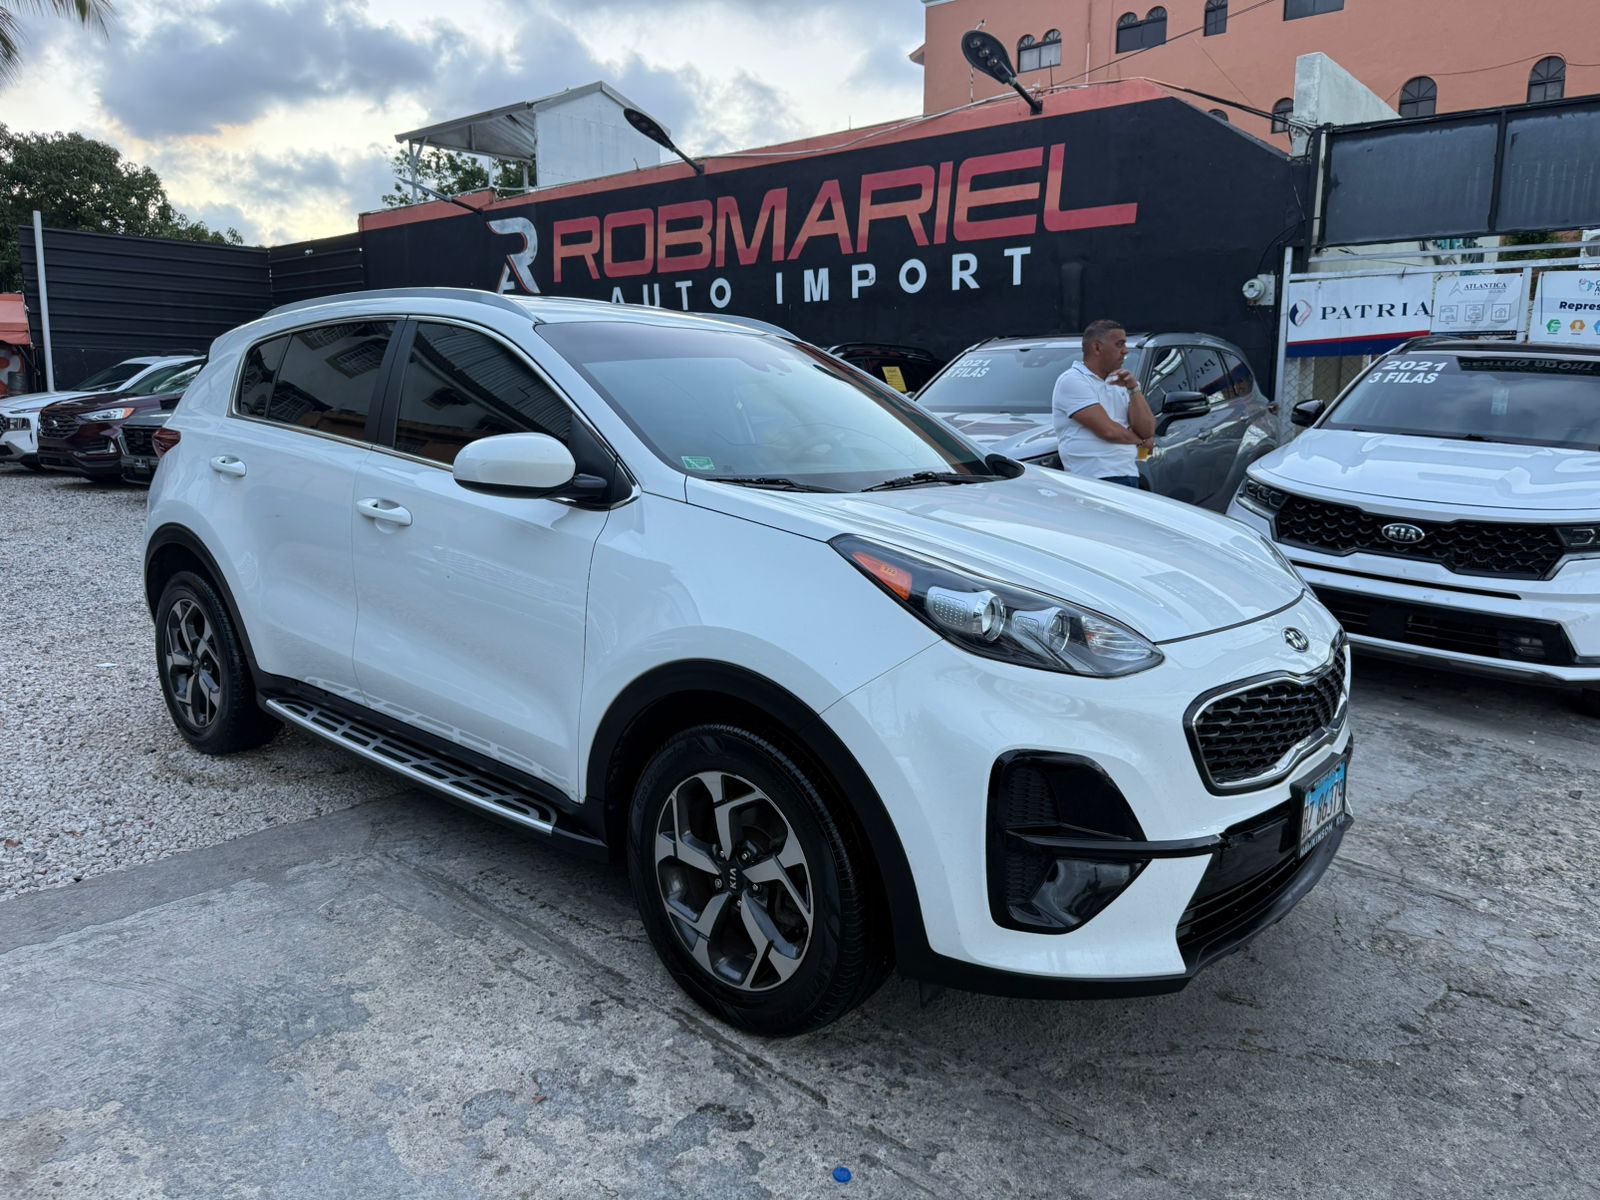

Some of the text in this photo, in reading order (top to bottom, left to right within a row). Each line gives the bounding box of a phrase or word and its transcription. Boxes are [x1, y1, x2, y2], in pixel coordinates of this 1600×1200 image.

[553, 143, 1138, 283] ROBMARIEL
[611, 247, 1031, 310] AUTO IMPORT
[1320, 301, 1430, 320] PATRIA
[950, 367, 990, 378] FILAS
[1381, 360, 1447, 371] 2021
[1367, 372, 1439, 384] 3 FILAS
[1388, 526, 1417, 540] KIA
